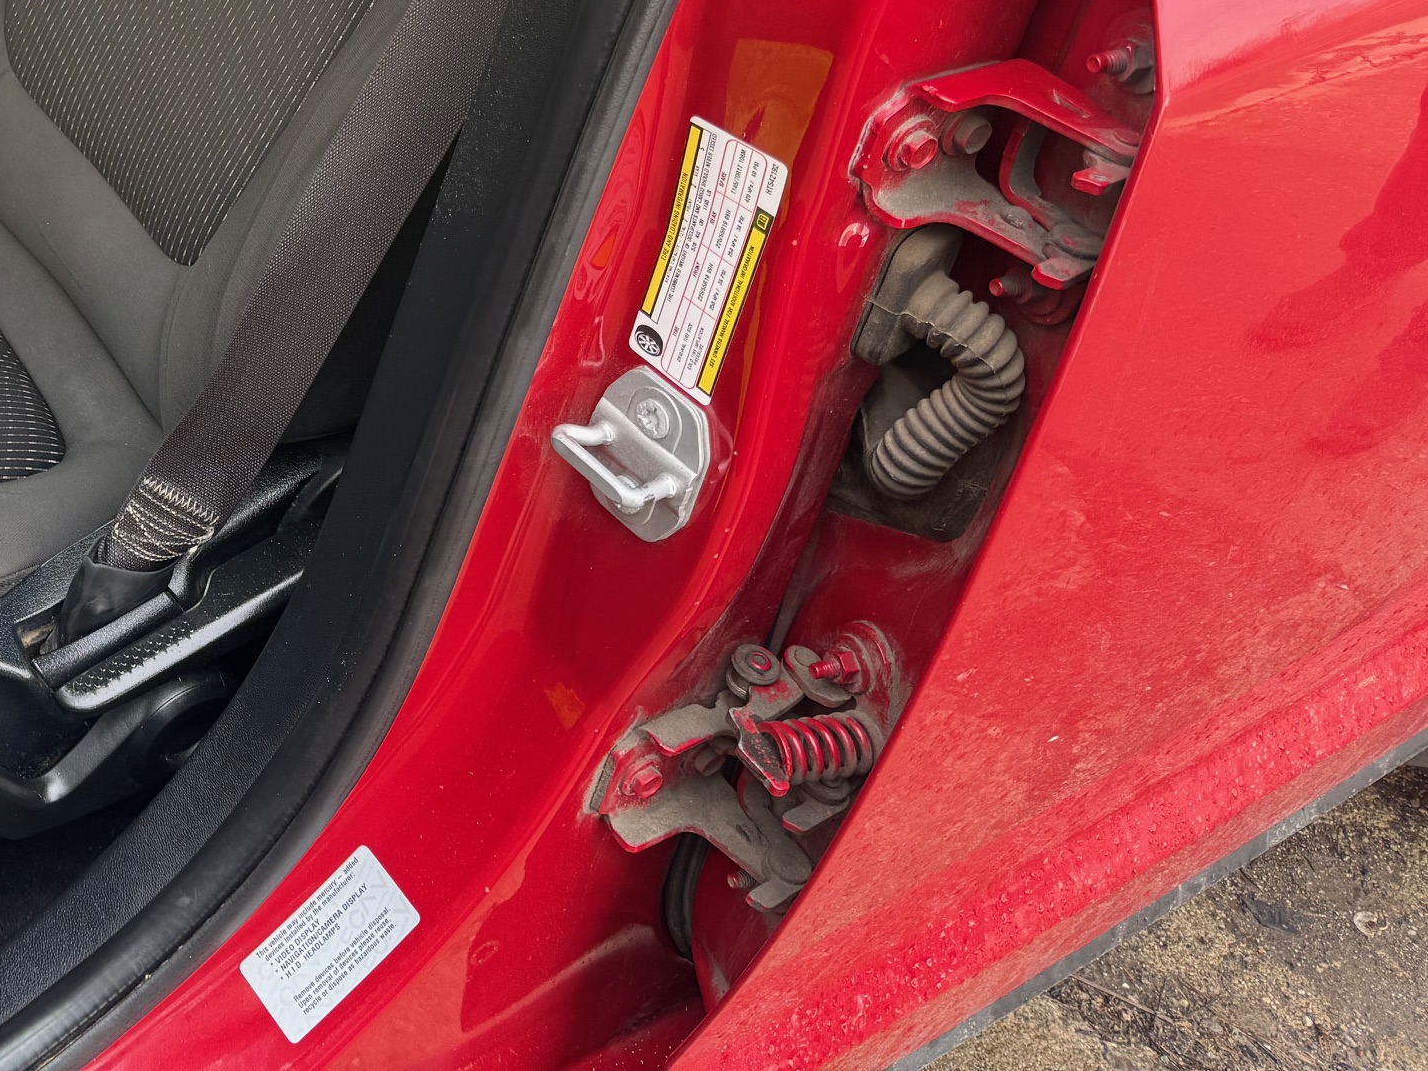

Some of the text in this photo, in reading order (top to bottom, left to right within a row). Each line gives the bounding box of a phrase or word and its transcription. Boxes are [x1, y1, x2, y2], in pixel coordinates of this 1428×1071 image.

[669, 209, 679, 234] LOADING
[675, 171, 687, 210] INFORMATION
[730, 164, 742, 194] T145/70R17
[765, 163, 778, 195] HT542192
[670, 268, 681, 292] COMBINED
[678, 249, 687, 267] WEIGHT
[687, 214, 697, 242] OCCUPANTS
[712, 337, 722, 358] OWNERS
[719, 317, 729, 338] MANUAL
[729, 278, 743, 306] ADDITIONAL
[740, 245, 754, 278] INFORMATION
[255, 944, 268, 958] This
[267, 927, 286, 948] vehicle
[286, 917, 299, 931] may
[297, 898, 316, 919] include
[316, 879, 337, 901] mercury
[341, 856, 358, 874] added
[264, 871, 355, 961] devices installed by the manufacturer:
[274, 918, 320, 964] VIDEO DISPLAY
[280, 882, 368, 971] NAVIGATION/CAMERA DISPLAY
[285, 922, 340, 978] H.I.D. HEADLAMPS
[293, 905, 391, 1002] Remove devices before vehicle disposal.
[297, 992, 313, 1009] Upon
[312, 973, 333, 995] removal
[338, 948, 358, 969] devices
[357, 931, 375, 951] please
[374, 916, 391, 934] reuse,
[302, 994, 322, 1015] recycle
[327, 969, 348, 991] dispose
[354, 937, 379, 964] hazardous
[378, 921, 396, 939] waste.
